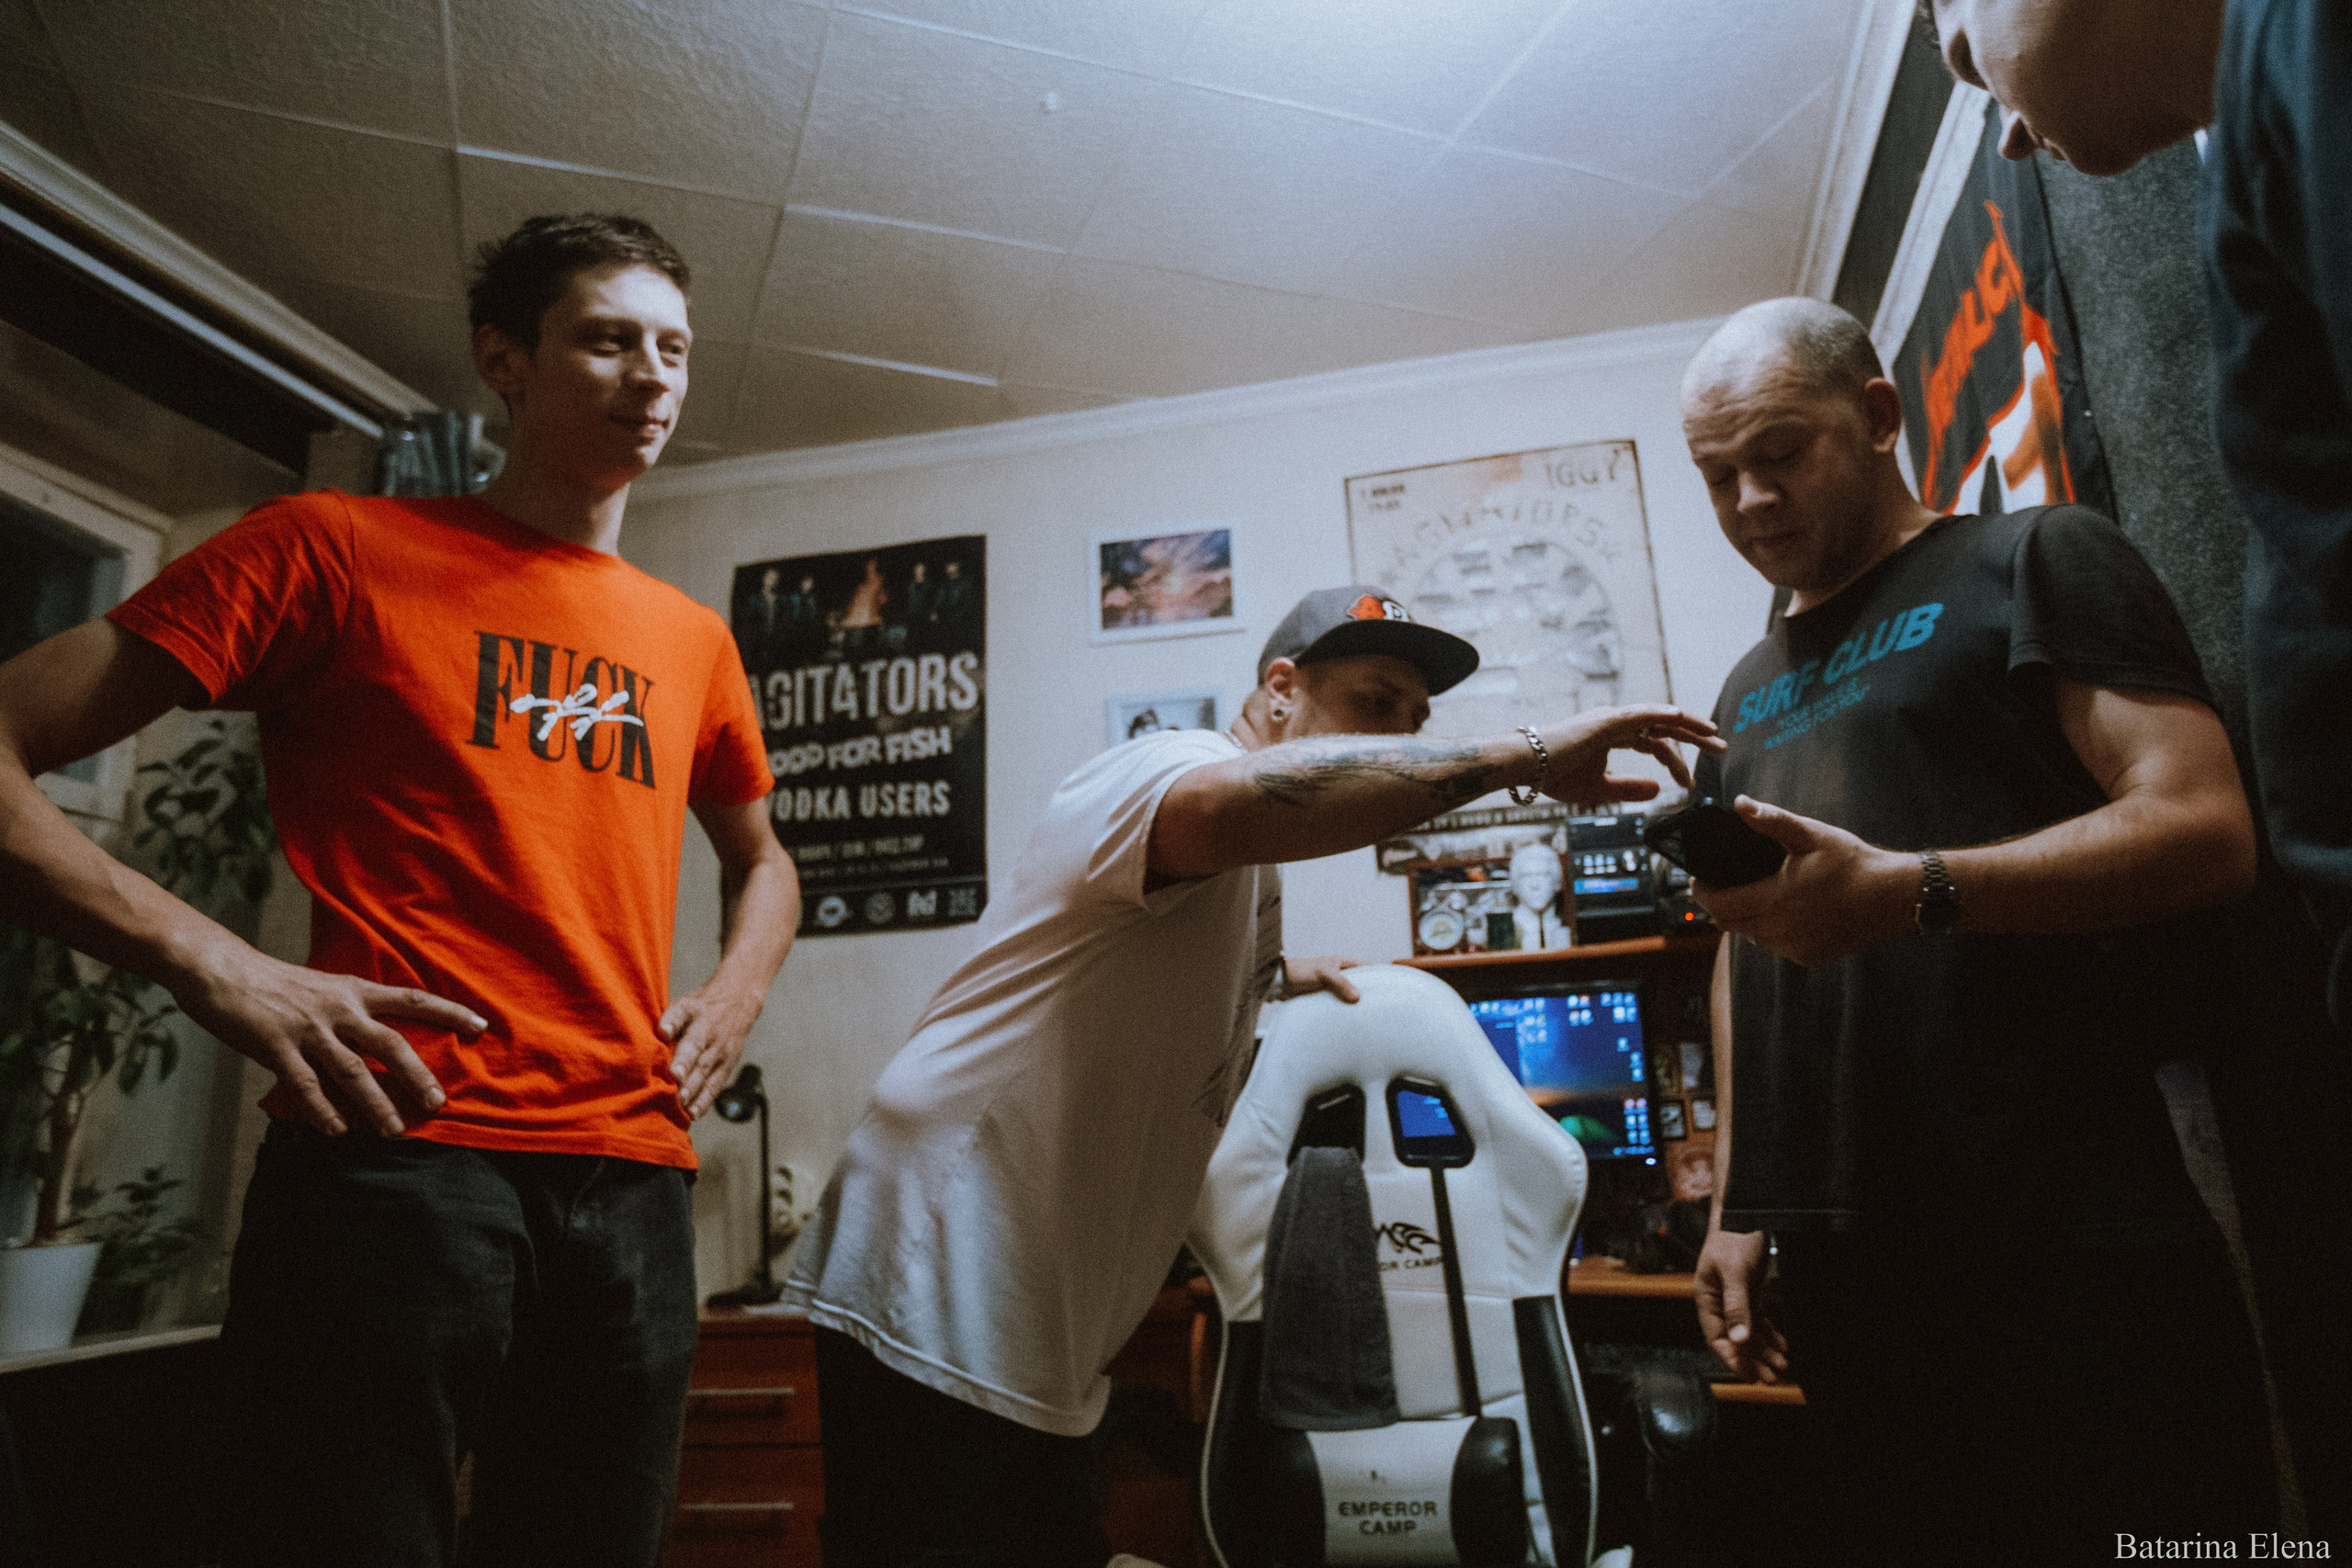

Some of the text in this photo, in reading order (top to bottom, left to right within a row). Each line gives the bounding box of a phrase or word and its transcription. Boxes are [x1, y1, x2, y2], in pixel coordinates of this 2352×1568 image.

[1734, 659, 1820, 733] SURF
[1823, 603, 1944, 685] CLUB
[466, 631, 656, 790] FUCK
[828, 735, 883, 770] FOR
[886, 728, 952, 763] FISH
[860, 781, 951, 817] USERS
[1338, 1500, 1439, 1518] EMPEROR
[1359, 1518, 1417, 1537] CAMP
